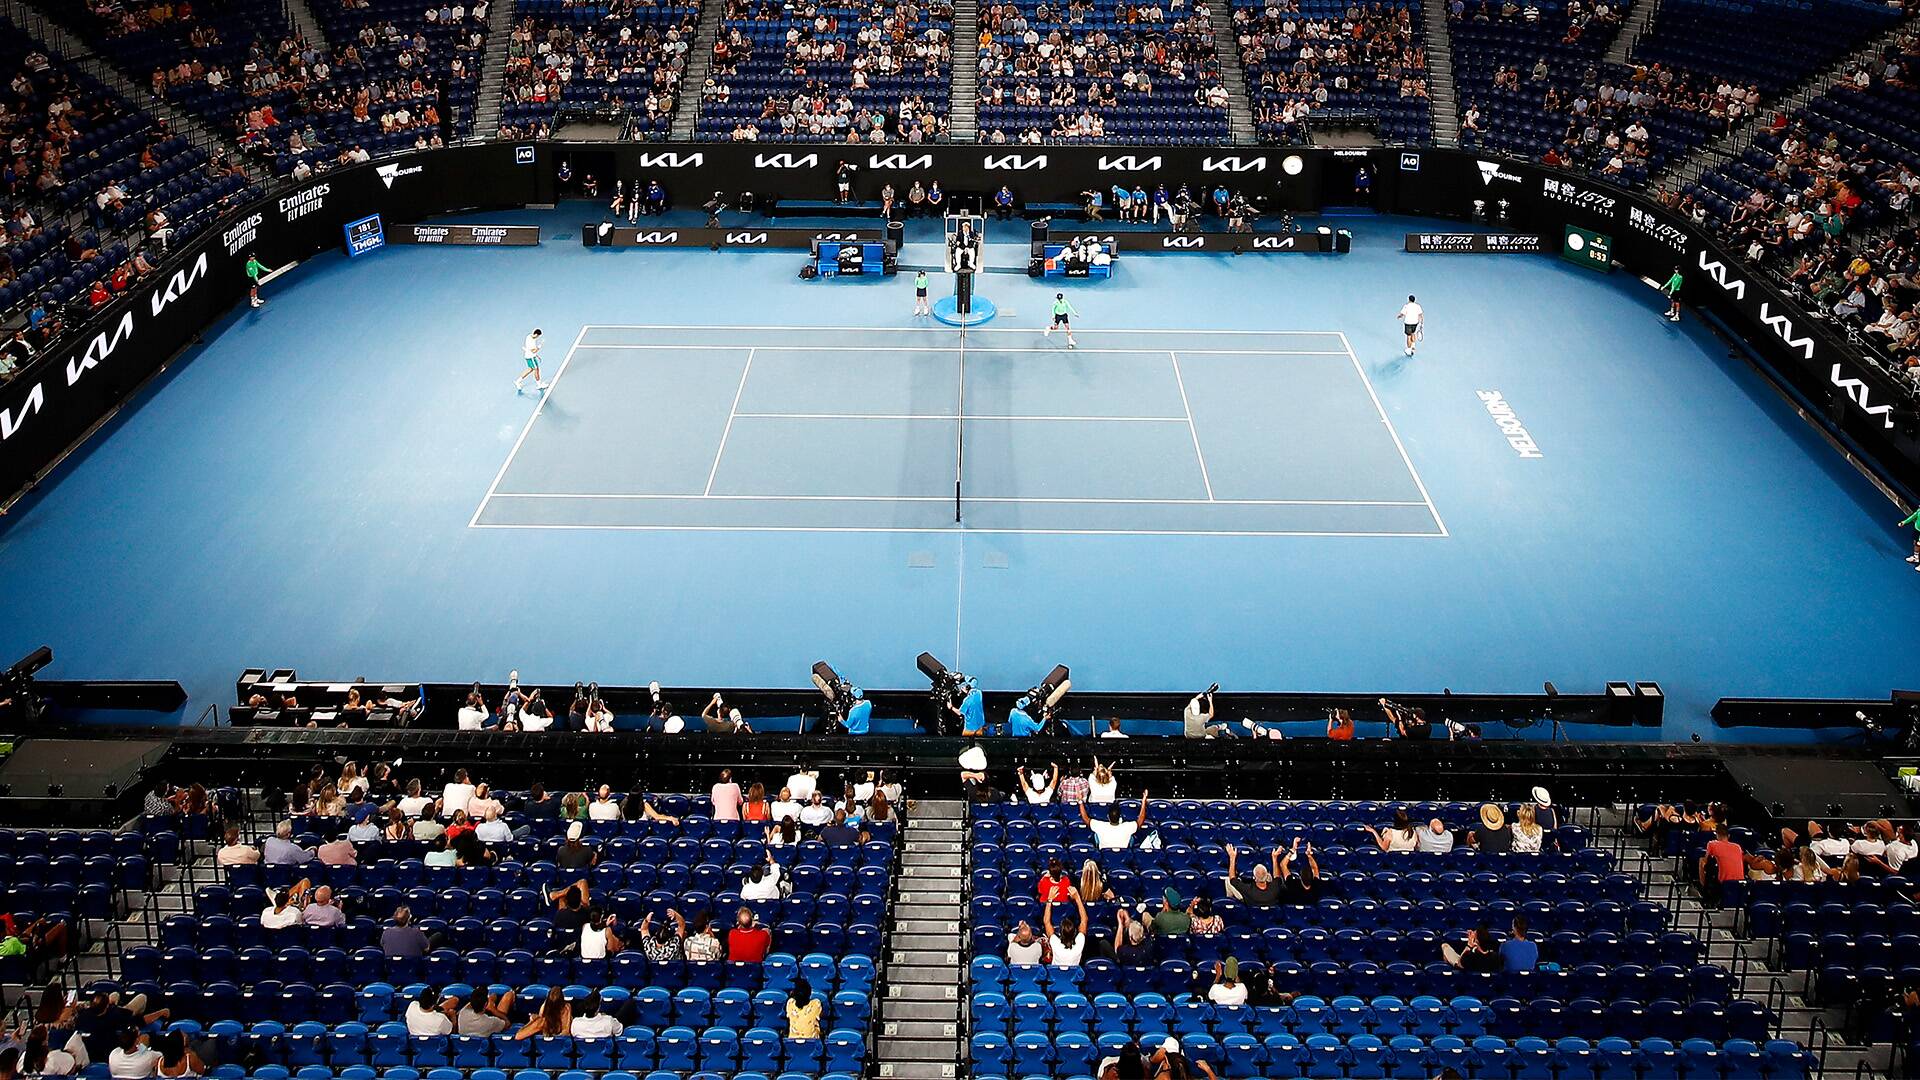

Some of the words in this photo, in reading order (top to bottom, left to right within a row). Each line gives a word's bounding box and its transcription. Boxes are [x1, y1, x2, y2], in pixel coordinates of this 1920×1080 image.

[518, 150, 532, 159] AO
[639, 152, 704, 168] KIA
[754, 153, 818, 169] KIA
[869, 153, 932, 169] KIA
[1403, 157, 1417, 166] AO
[984, 154, 1048, 170] KIA
[1098, 155, 1162, 171] KIA
[1202, 156, 1266, 172] KIA
[279, 183, 331, 213] Emirates
[299, 197, 323, 217] BETTER
[222, 212, 263, 247] Emirates
[358, 222, 371, 233] 181
[413, 226, 449, 236] Emirates
[472, 227, 507, 236] Emirates
[636, 232, 678, 243] KIA
[726, 232, 767, 244] KIA
[1163, 236, 1205, 248] KIA
[1253, 237, 1294, 248] KIA
